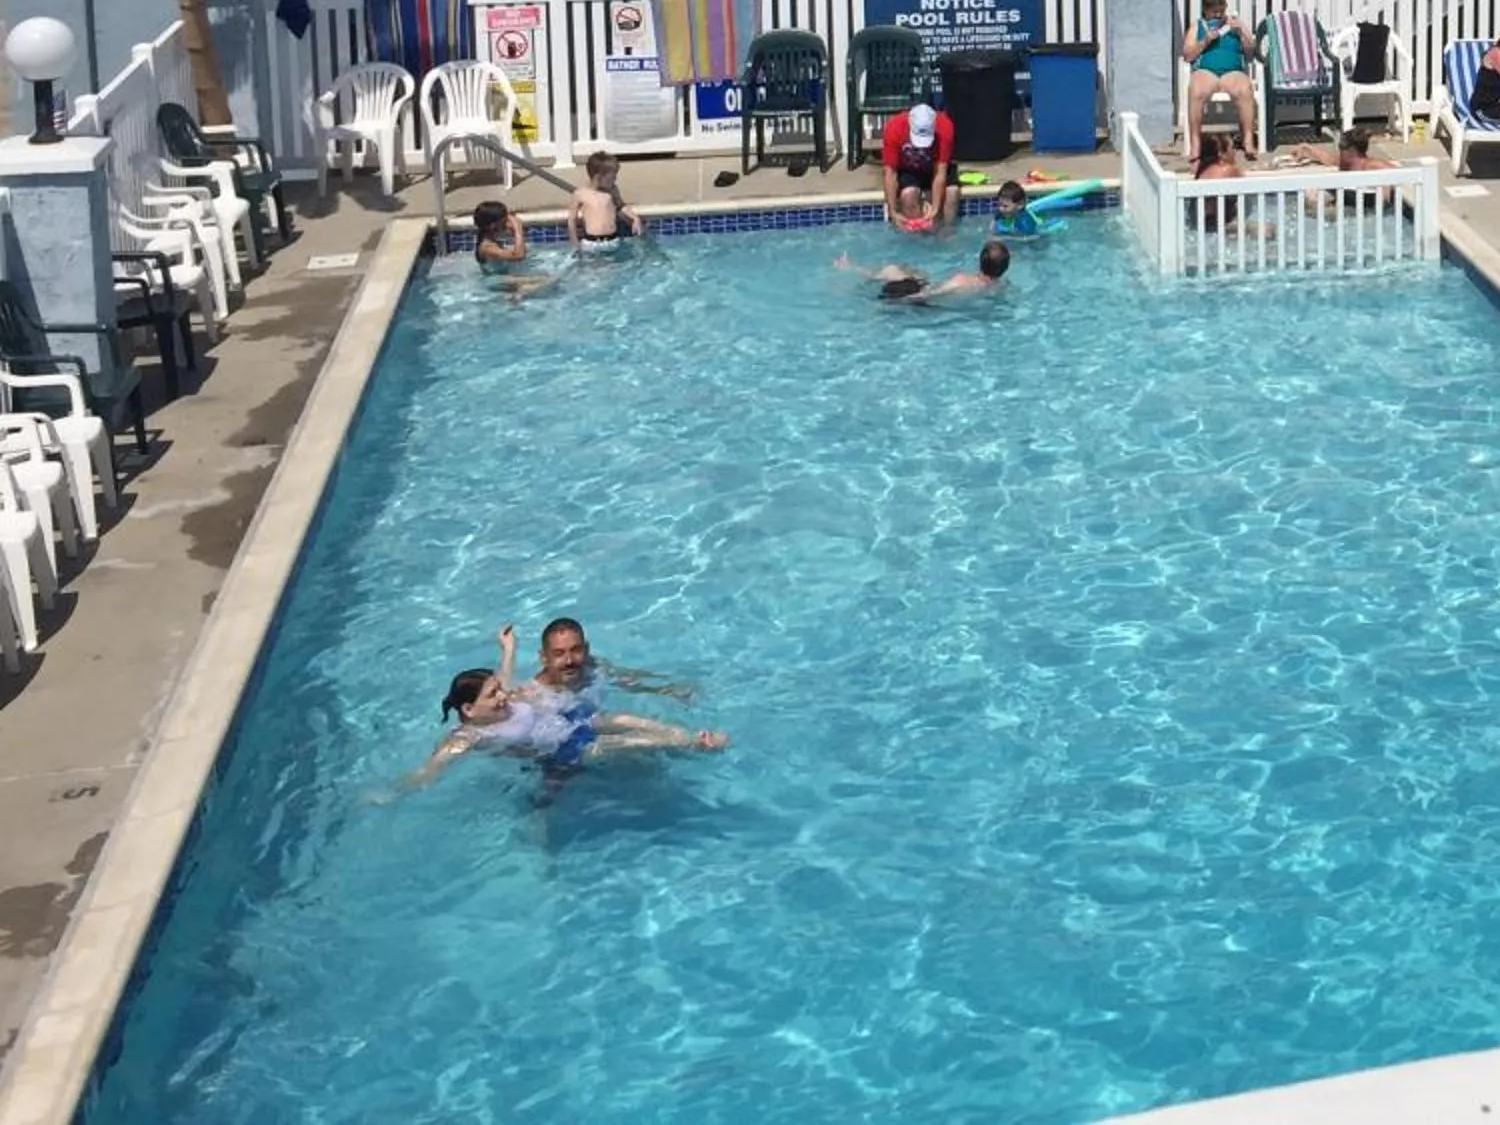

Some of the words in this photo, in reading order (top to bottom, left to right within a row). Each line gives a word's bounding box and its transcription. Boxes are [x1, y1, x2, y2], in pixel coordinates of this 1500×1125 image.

[895, 12, 950, 26] POOL
[956, 9, 1021, 24] RULES
[717, 121, 742, 132] Swim
